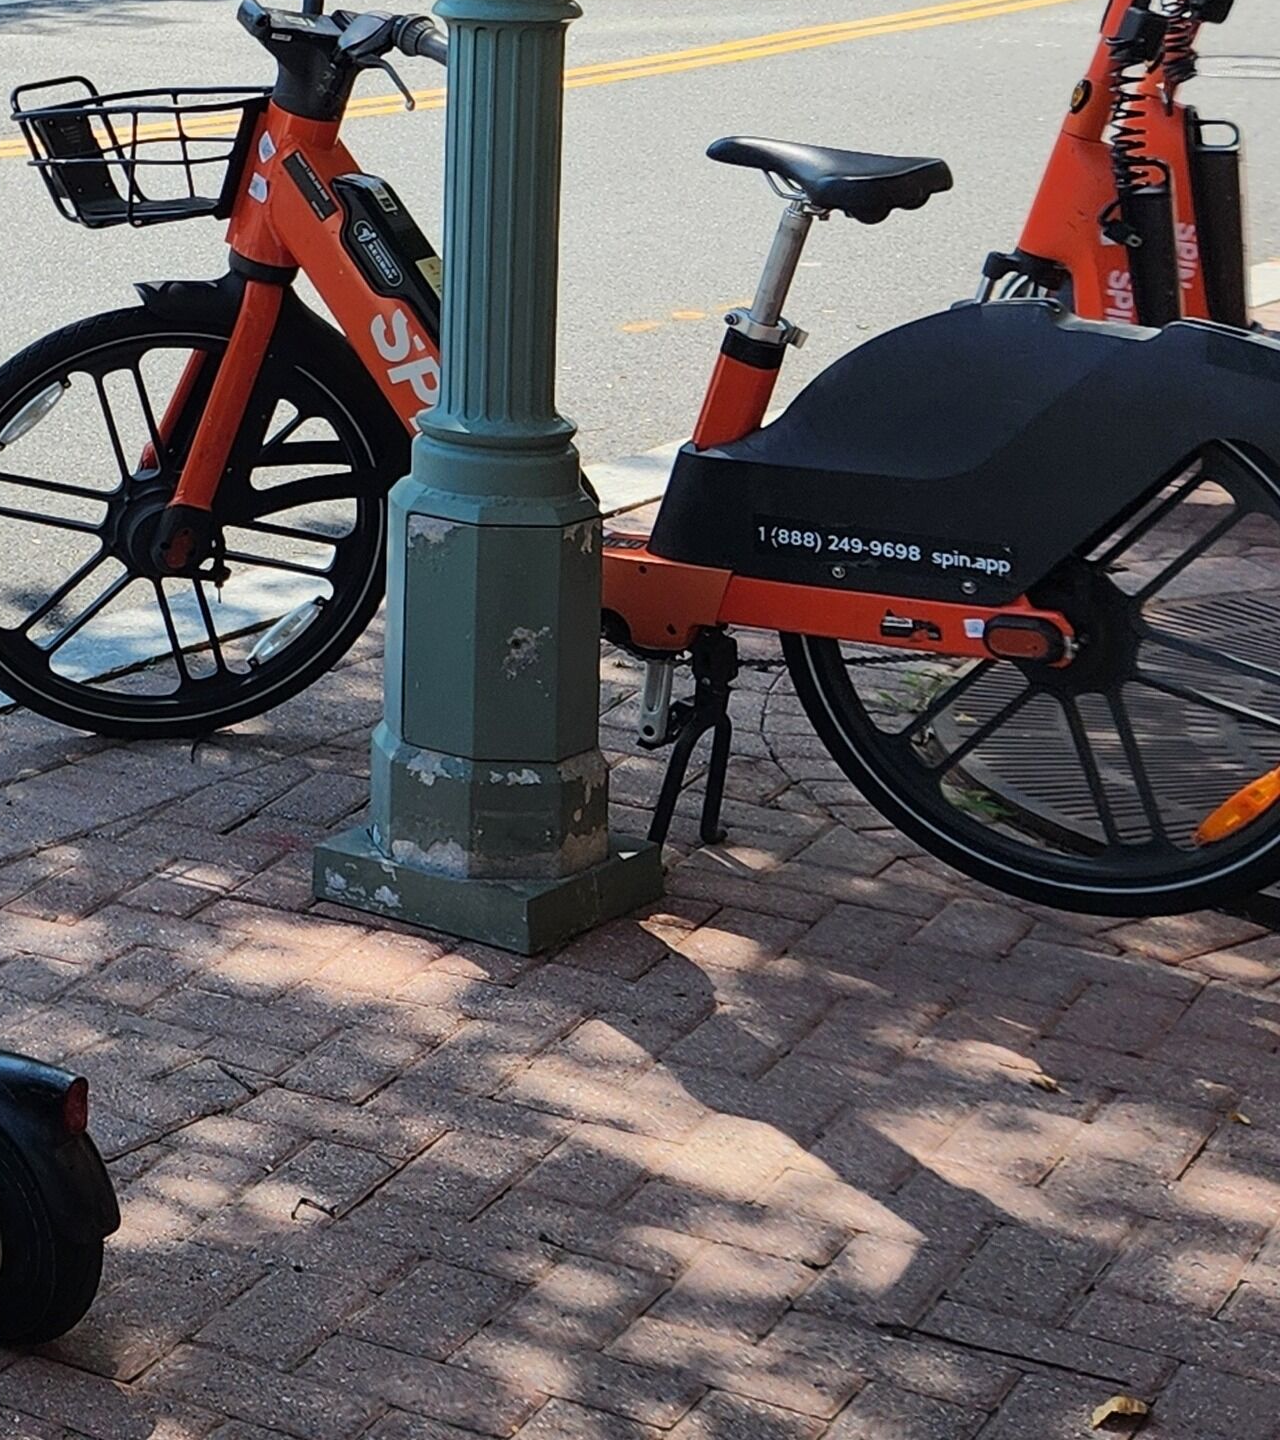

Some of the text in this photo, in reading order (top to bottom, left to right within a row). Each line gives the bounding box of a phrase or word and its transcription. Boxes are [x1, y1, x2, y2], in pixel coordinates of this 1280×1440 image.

[370, 308, 441, 436] SP
[758, 525, 1012, 577] 1 (888) 249-9698 spin.app
